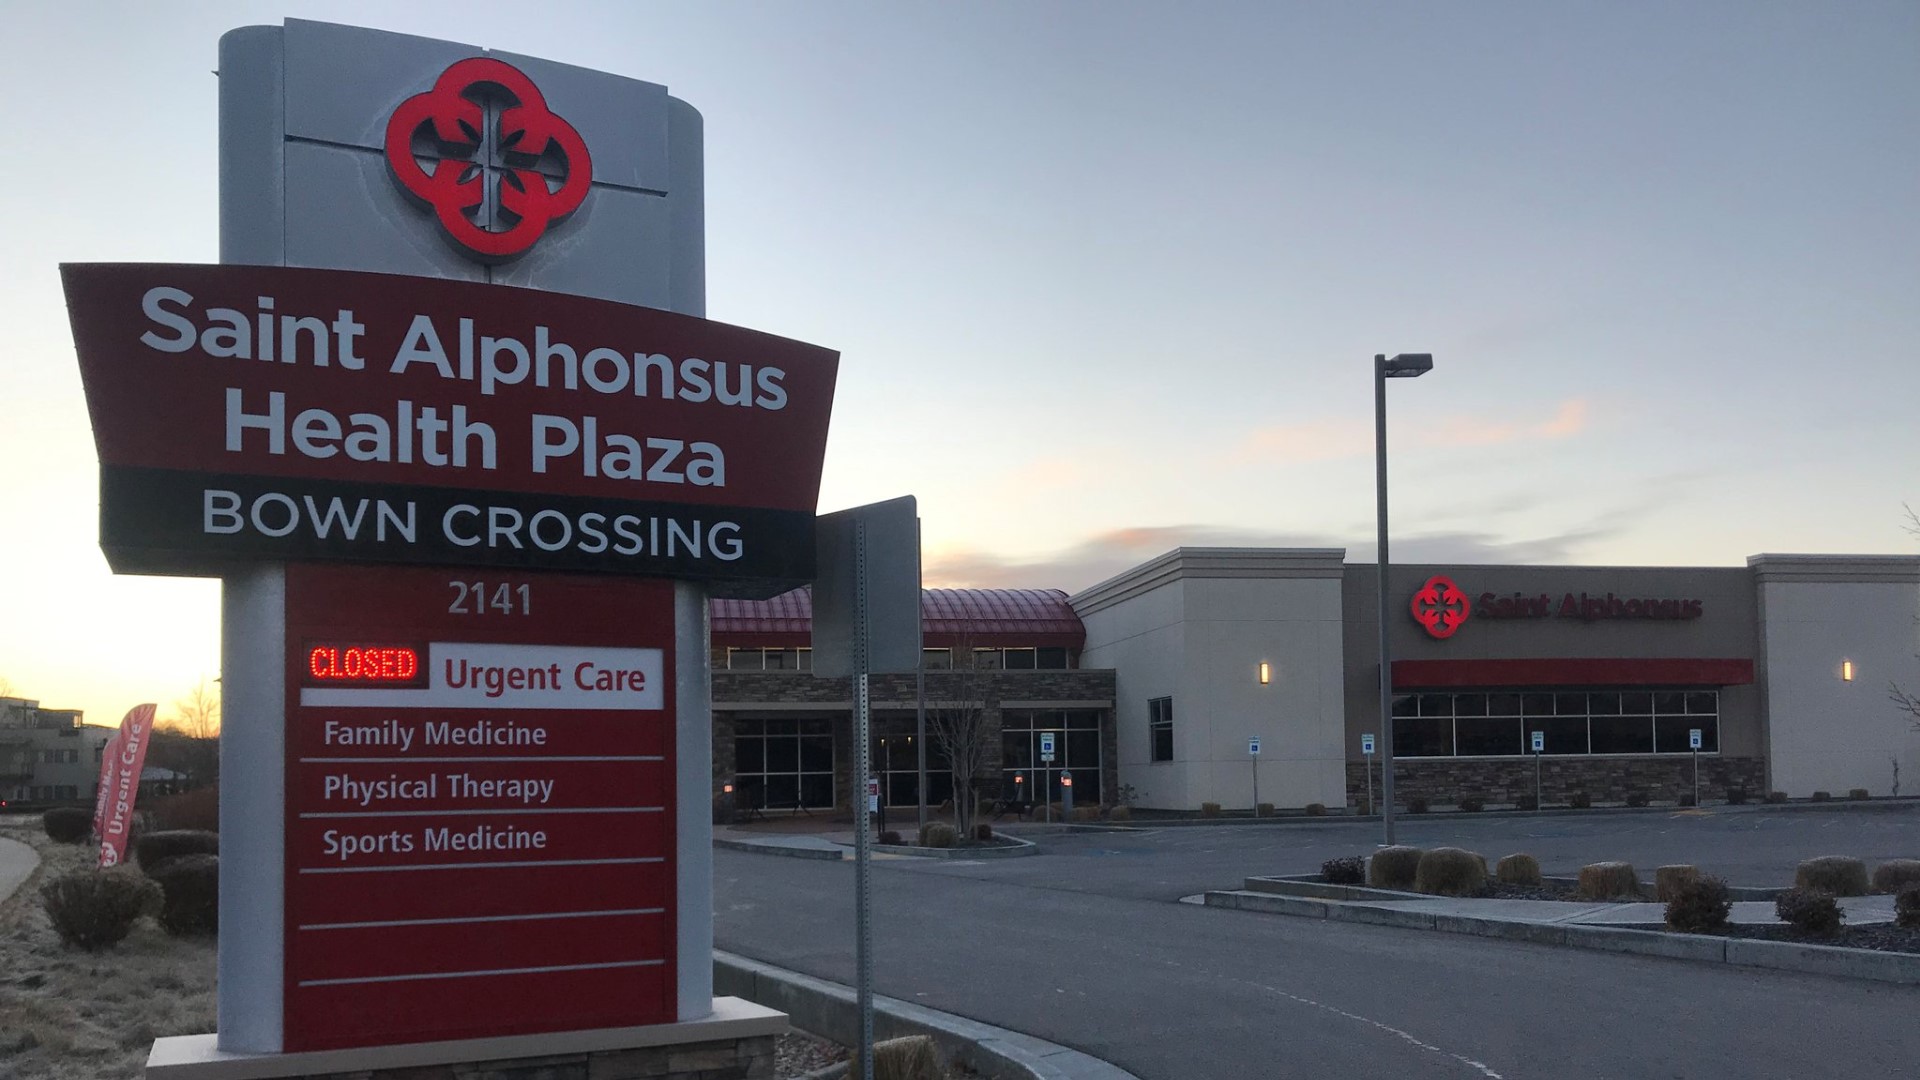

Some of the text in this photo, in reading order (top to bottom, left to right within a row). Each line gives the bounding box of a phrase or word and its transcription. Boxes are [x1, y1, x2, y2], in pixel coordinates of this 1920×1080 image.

[139, 286, 788, 411] Saint Alphonsus
[225, 388, 726, 488] Health Plaza
[203, 489, 744, 561] BOWN CROSSING
[448, 581, 531, 616] 2141
[1476, 592, 1549, 618] Saint
[309, 646, 417, 679] CLOSED
[445, 658, 646, 697] Urgent Care
[324, 720, 547, 751] Family Medicine
[108, 770, 132, 835] Urgent
[121, 723, 142, 765] Care
[324, 774, 554, 806] Physical Therapy
[323, 826, 547, 860] Sports Medicine
